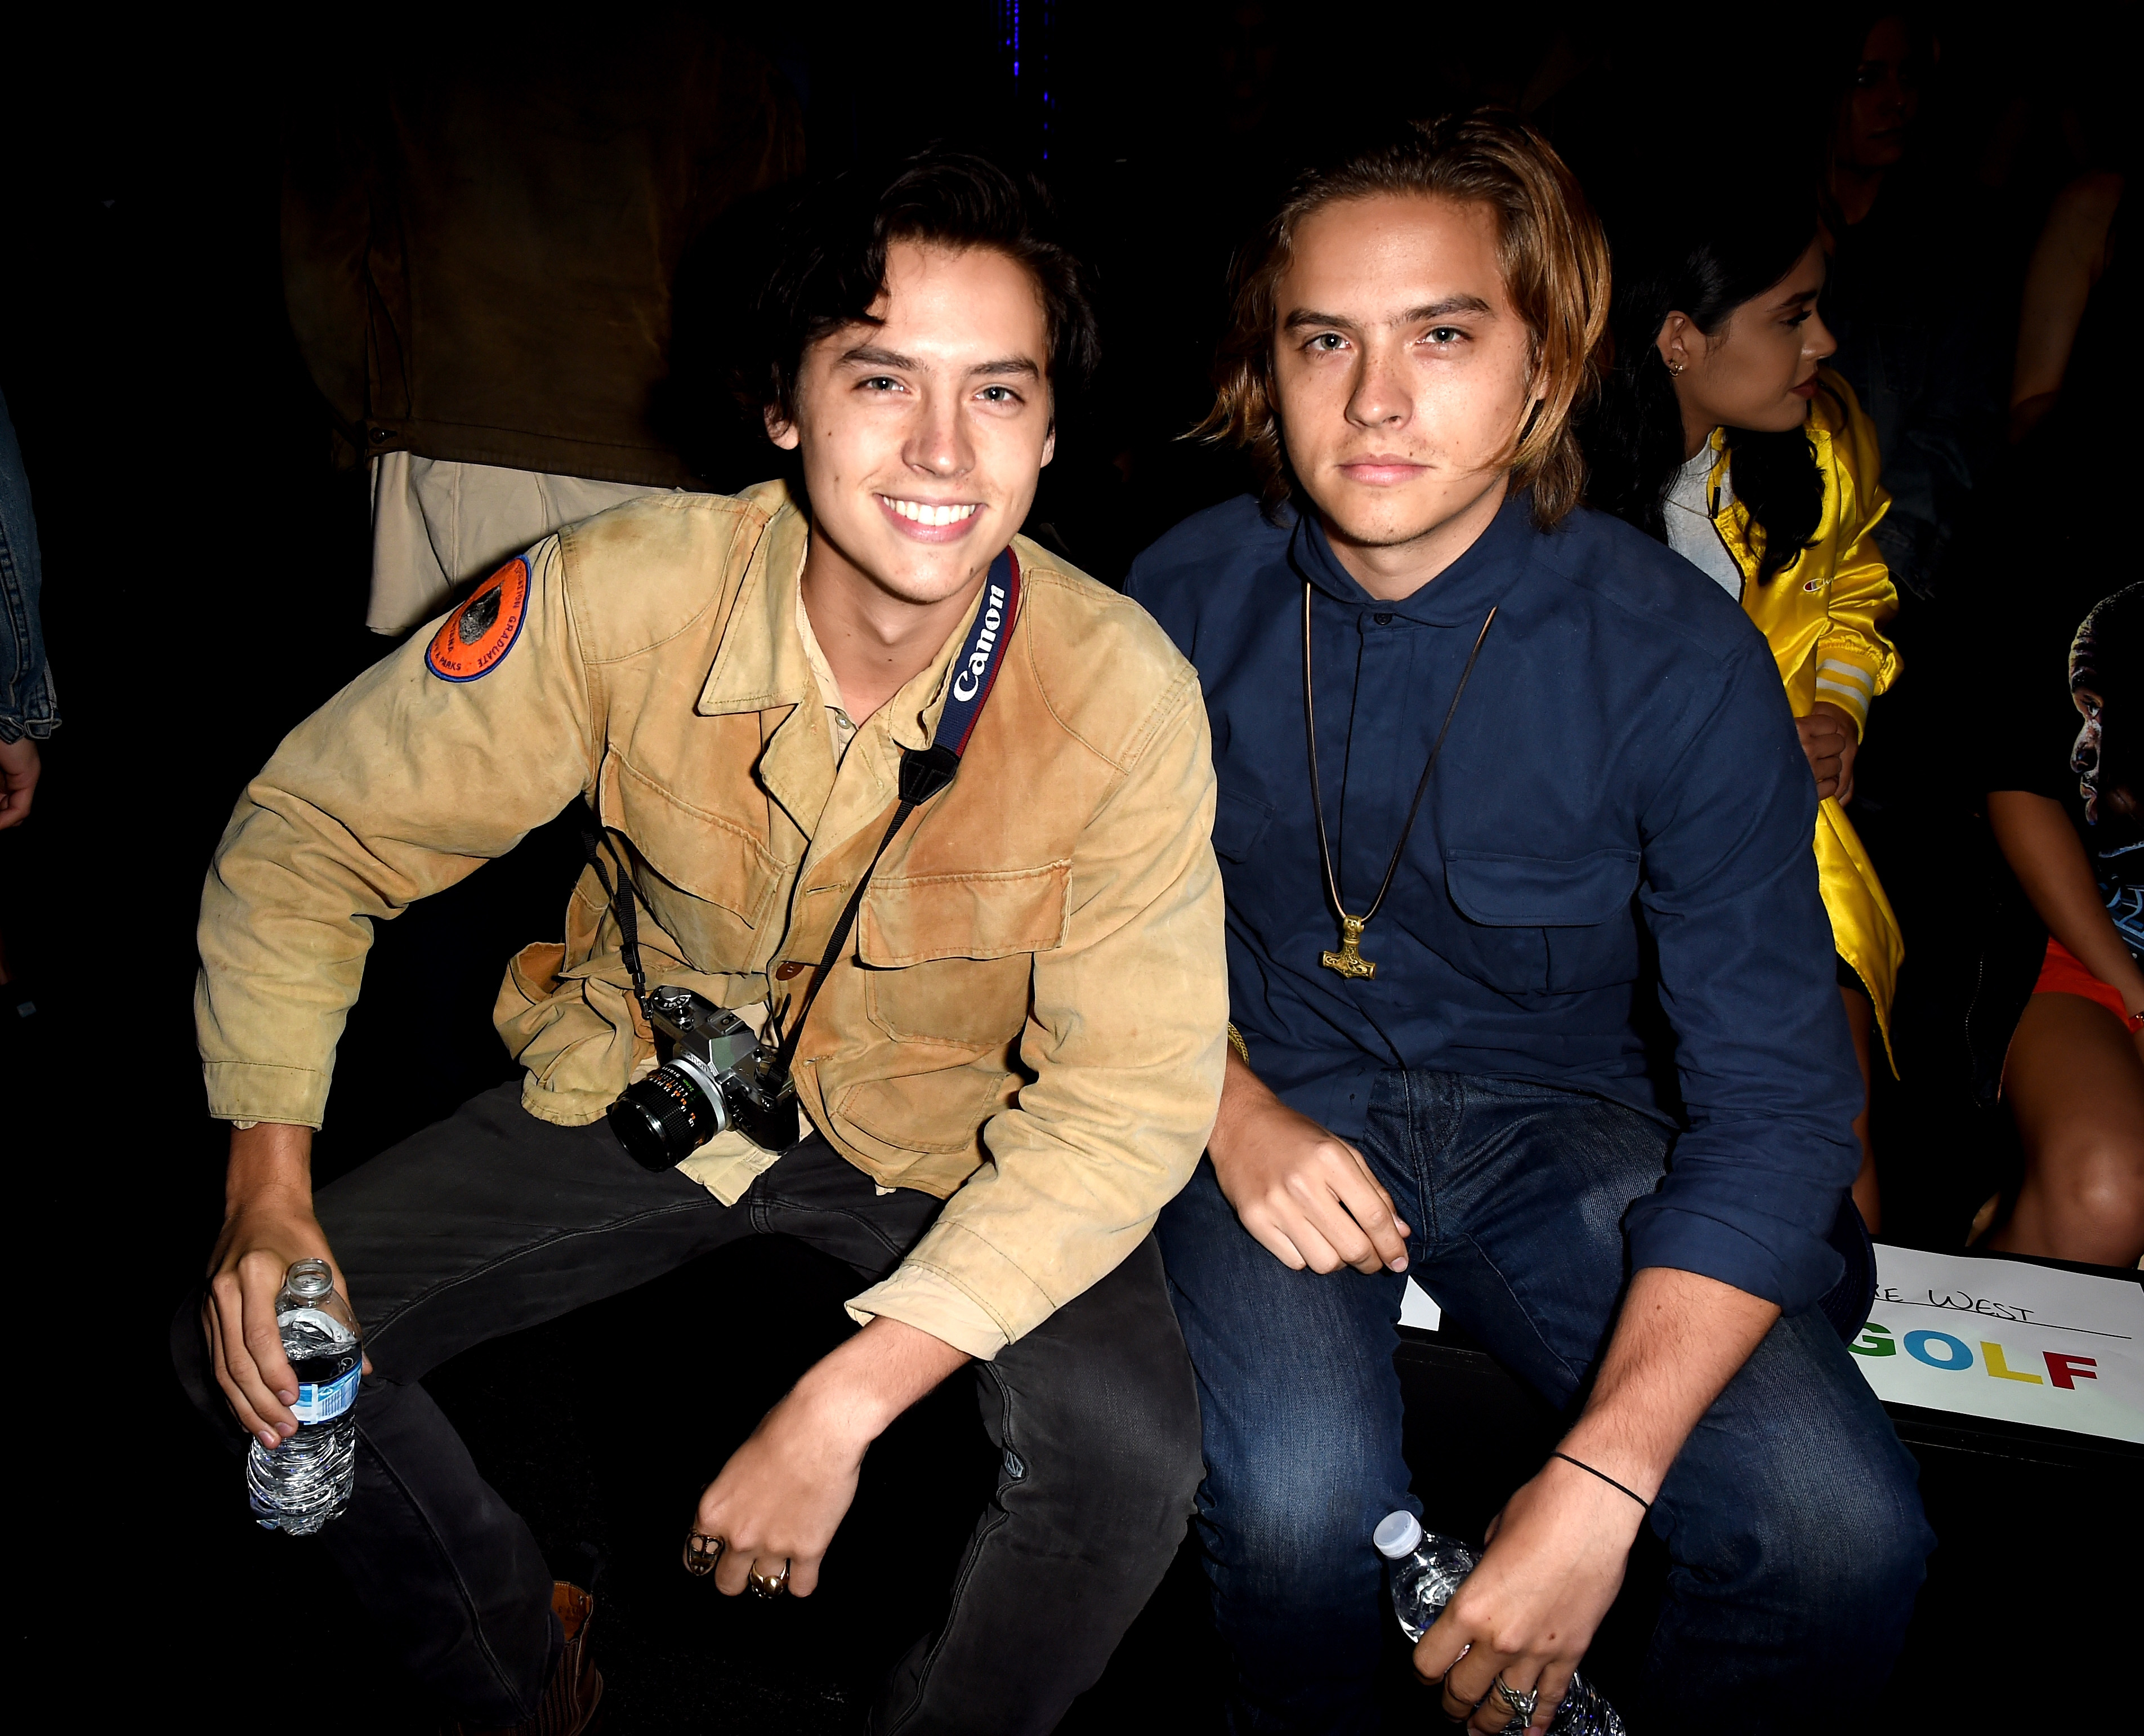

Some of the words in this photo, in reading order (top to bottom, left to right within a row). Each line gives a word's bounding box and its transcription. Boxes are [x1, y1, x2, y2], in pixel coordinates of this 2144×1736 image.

[439, 657, 462, 671] PARKS
[478, 616, 516, 668] GRADUATE
[953, 583, 1006, 703] Canon
[1928, 1289, 2034, 1321] WEST
[1847, 1321, 2098, 1390] GOLF
